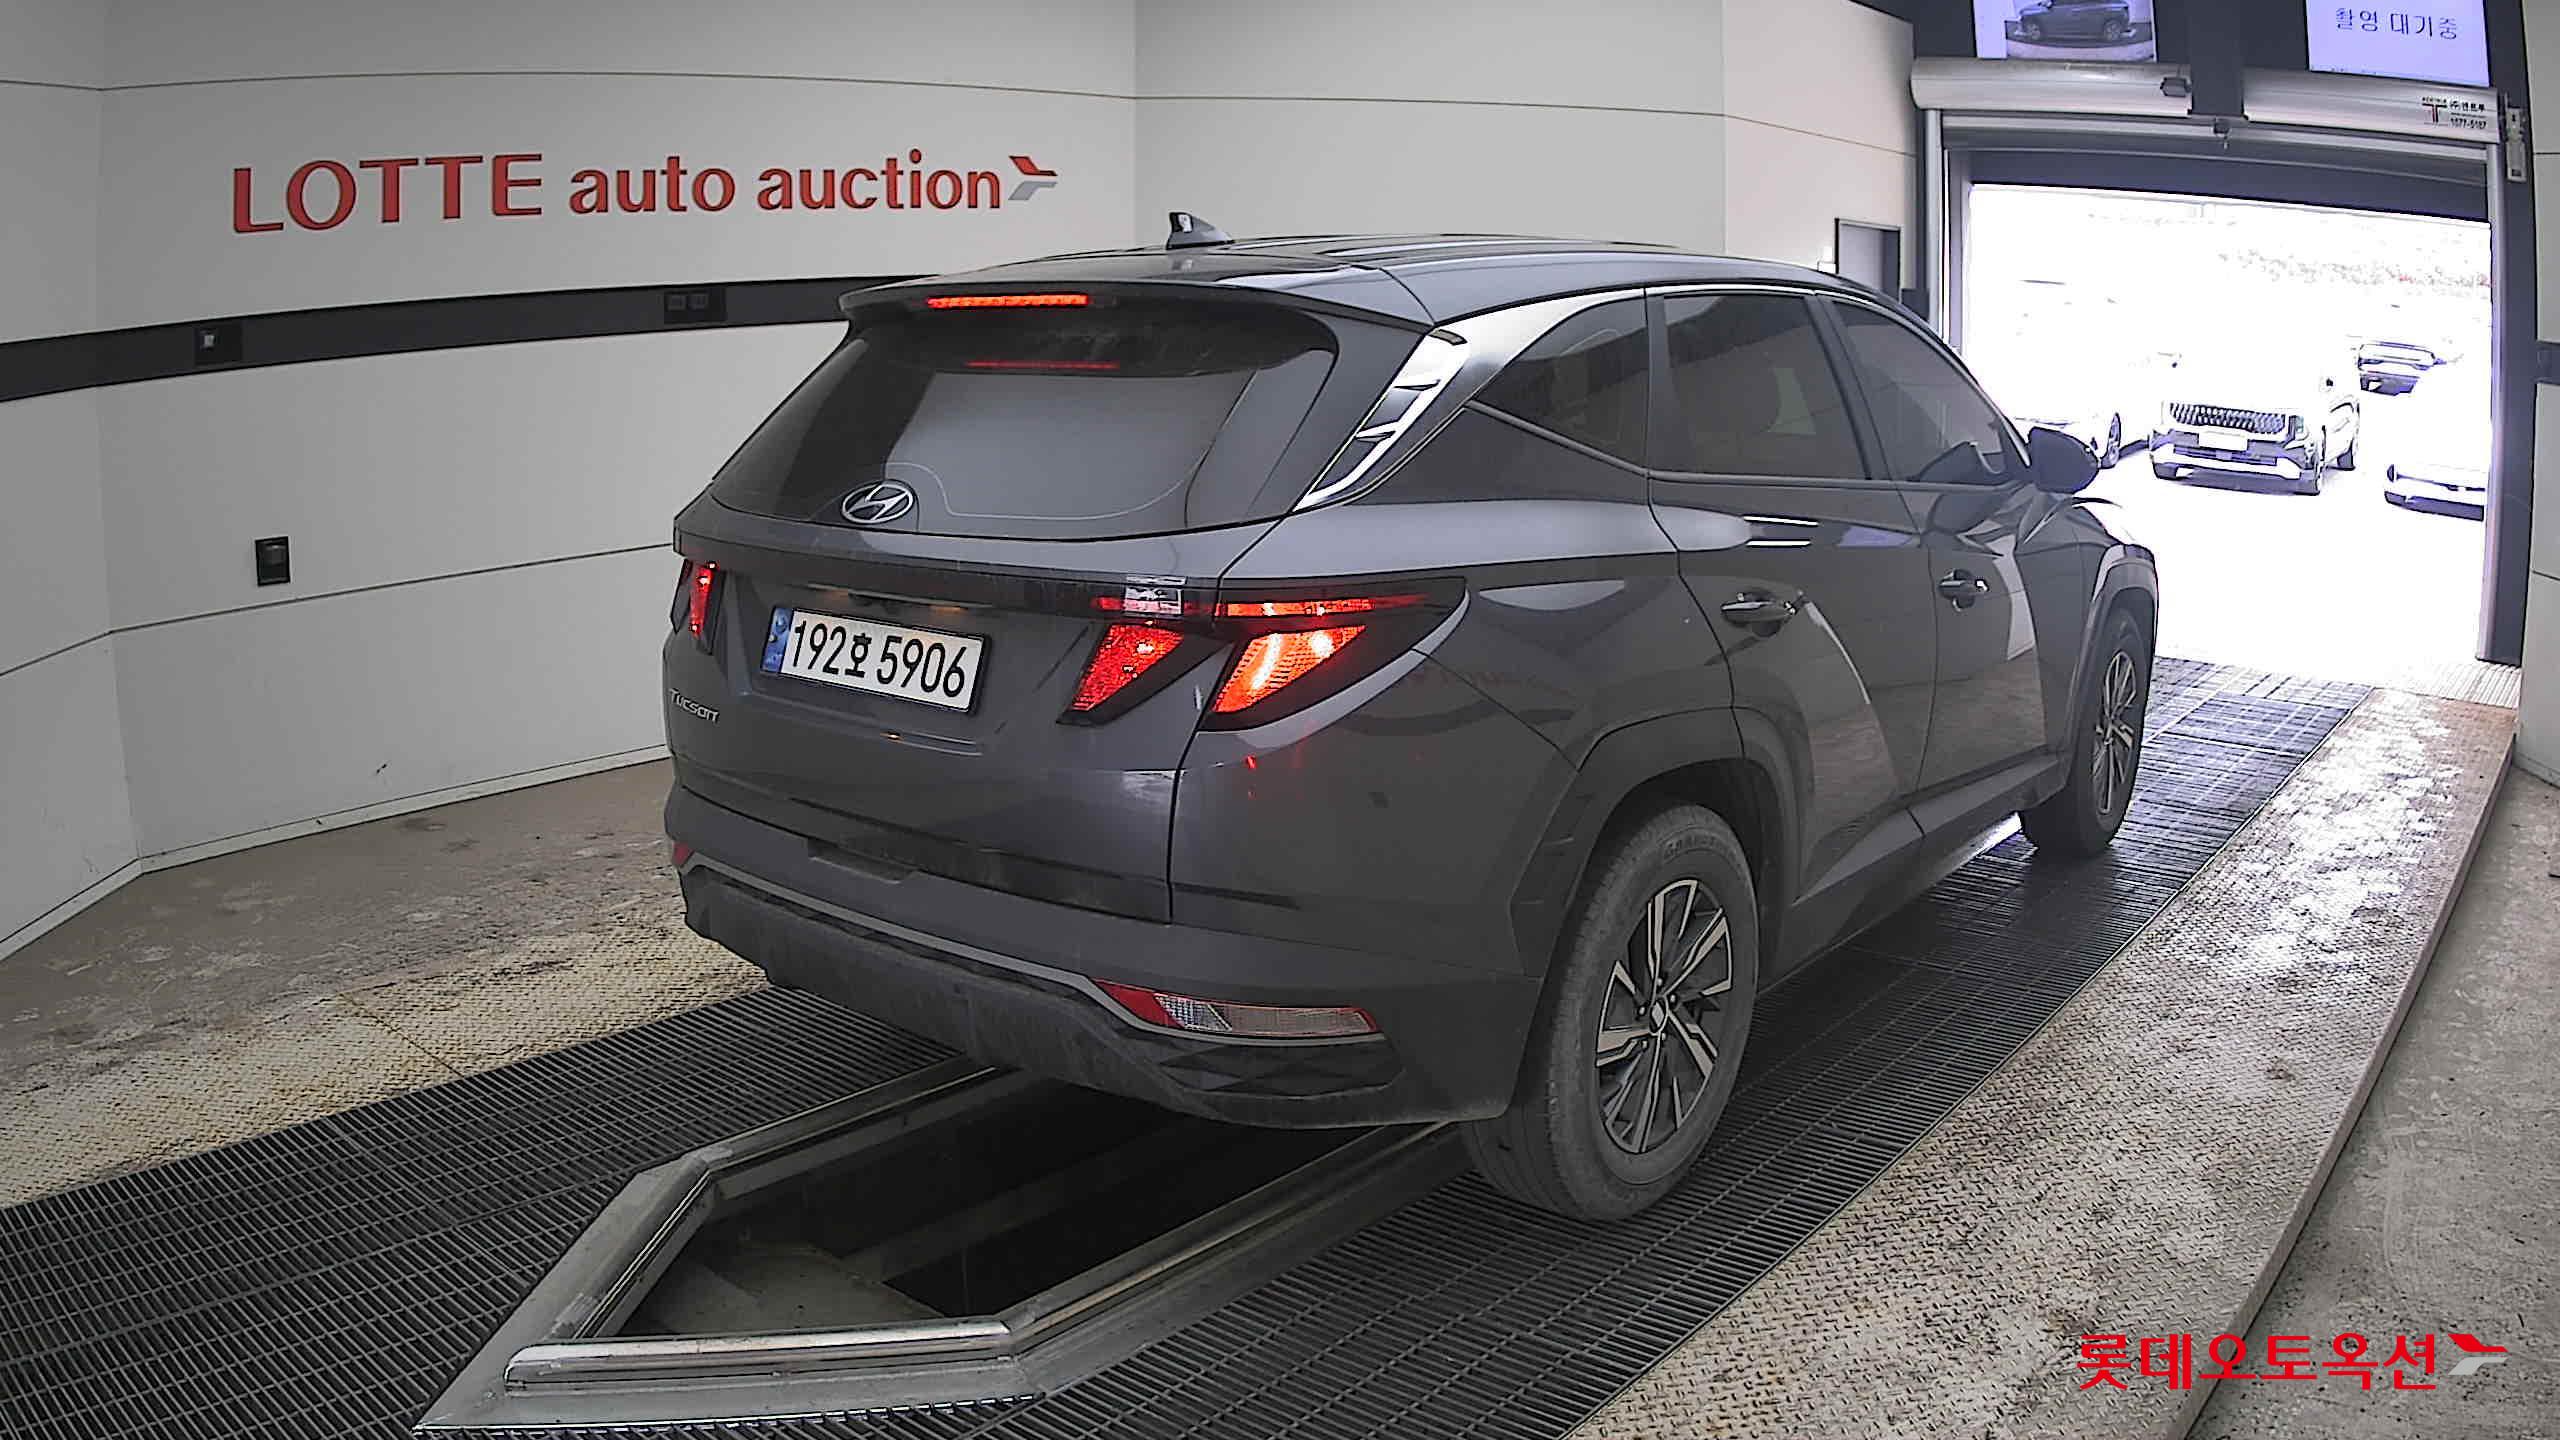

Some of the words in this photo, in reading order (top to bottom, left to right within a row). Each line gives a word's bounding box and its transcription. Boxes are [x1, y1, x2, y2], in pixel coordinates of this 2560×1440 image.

[2335, 7, 2378, 32] 촬영
[233, 153, 542, 233] LOTTE
[569, 155, 737, 214] auto
[756, 148, 1002, 211] auction
[876, 634, 967, 698] 5906
